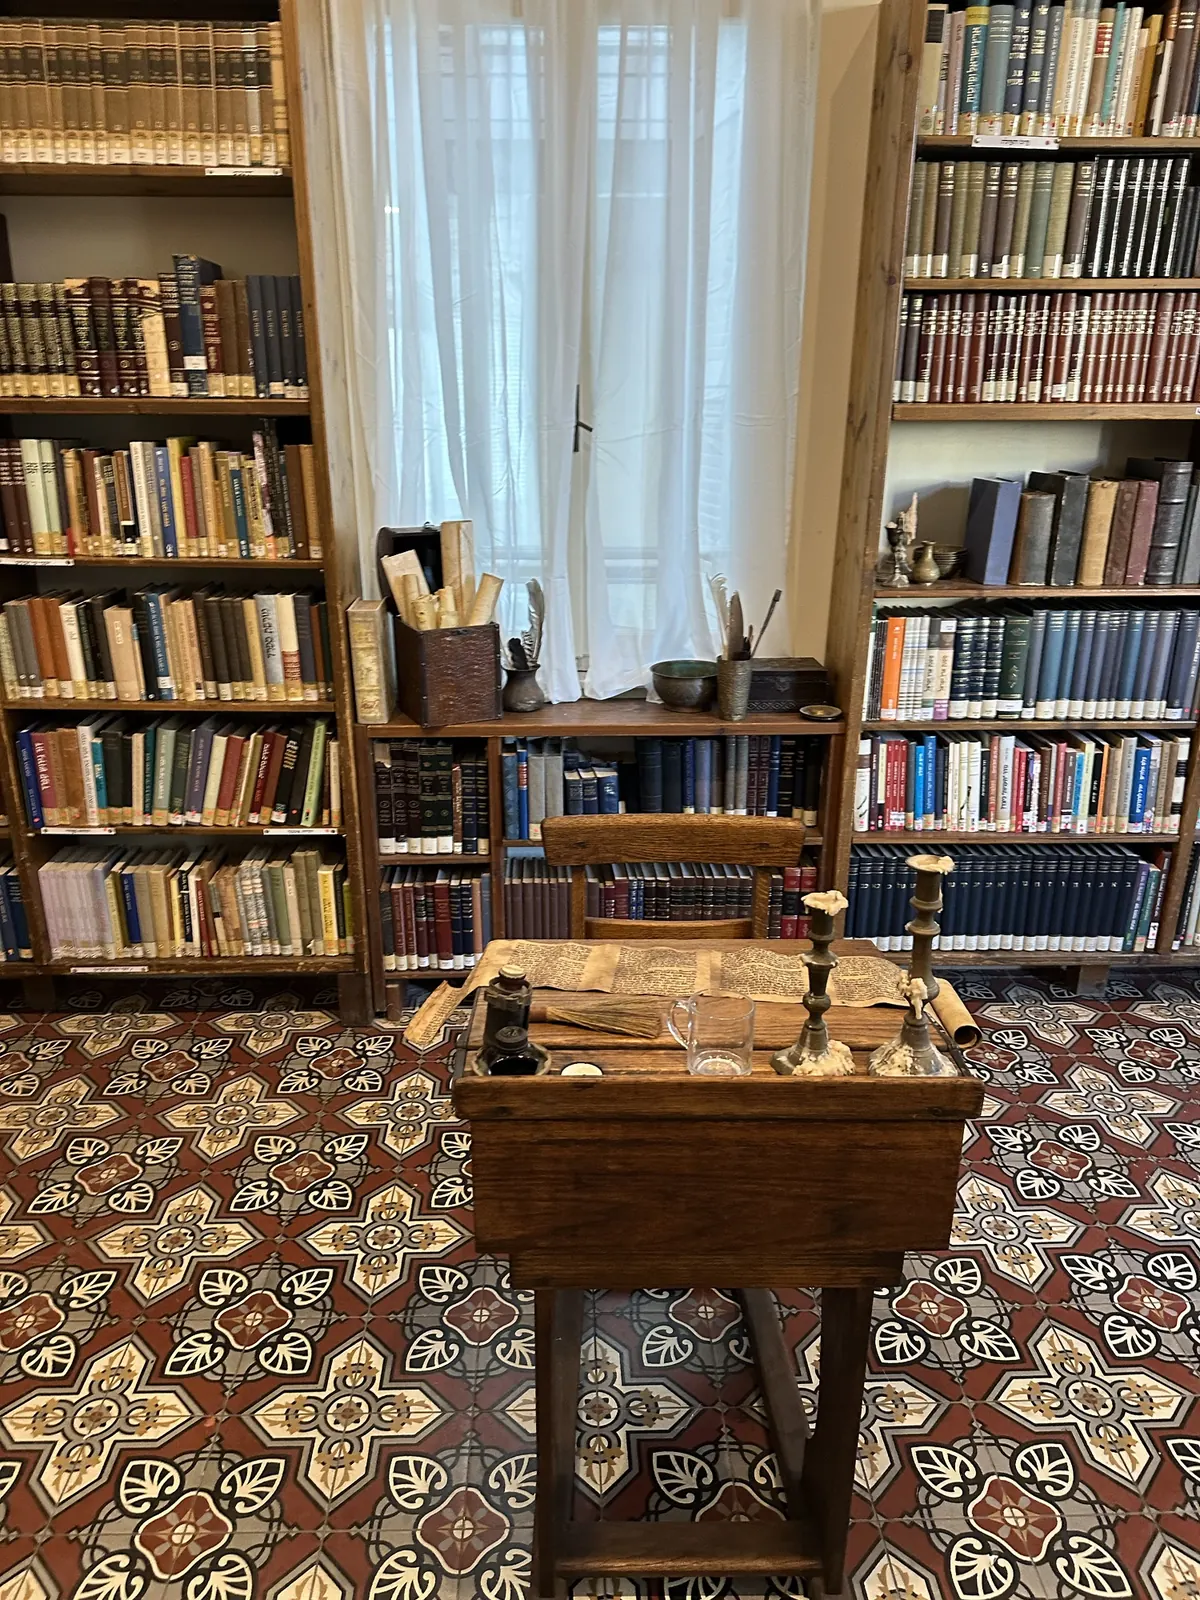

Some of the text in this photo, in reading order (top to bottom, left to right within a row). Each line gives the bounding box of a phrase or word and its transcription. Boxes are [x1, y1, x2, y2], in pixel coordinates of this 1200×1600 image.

[965, 26, 982, 103] ארץ ישראל ופיוטיה
[264, 636, 276, 659] ספרד
